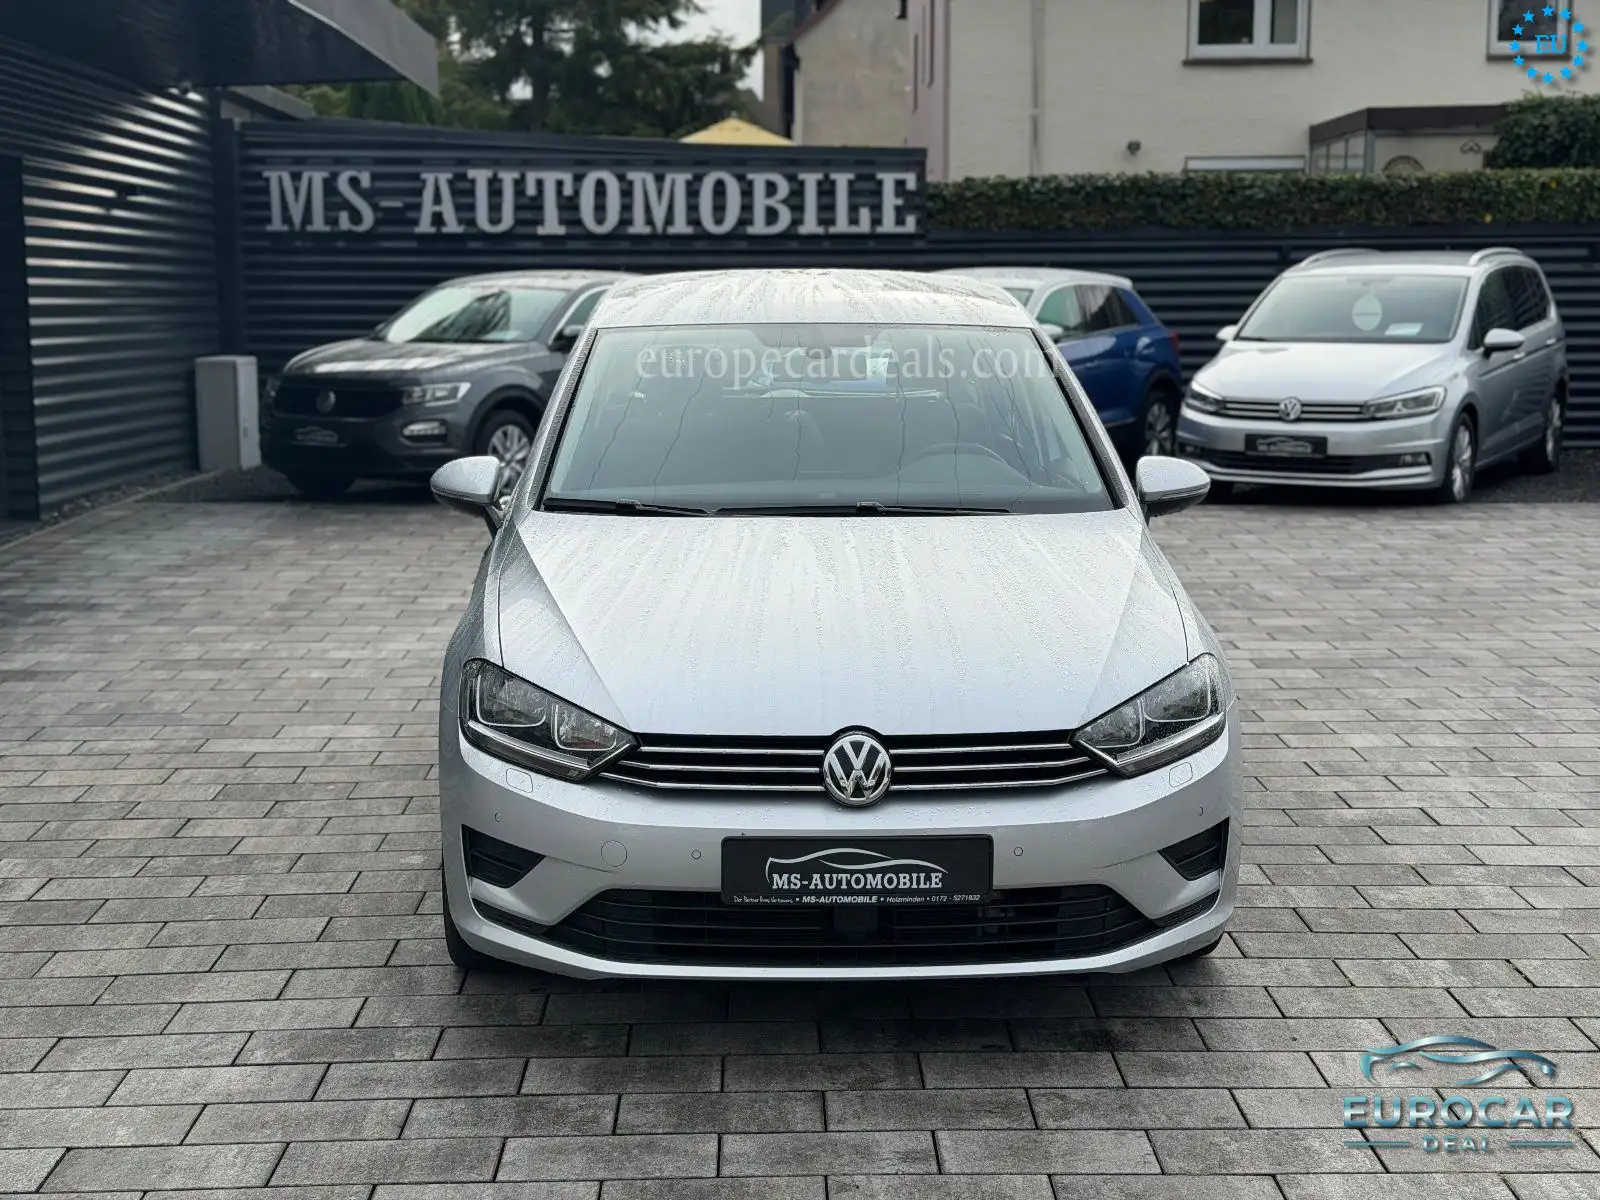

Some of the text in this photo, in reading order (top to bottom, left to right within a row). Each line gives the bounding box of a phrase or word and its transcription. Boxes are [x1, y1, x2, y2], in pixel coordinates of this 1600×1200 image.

[262, 168, 917, 236] MS-AUTOMOBILE
[771, 873, 943, 890] MS-AUTOMOBILE
[802, 895, 878, 904] MS-AUTOMOBILE
[886, 896, 925, 904] Holzminden
[931, 895, 948, 903] 0172
